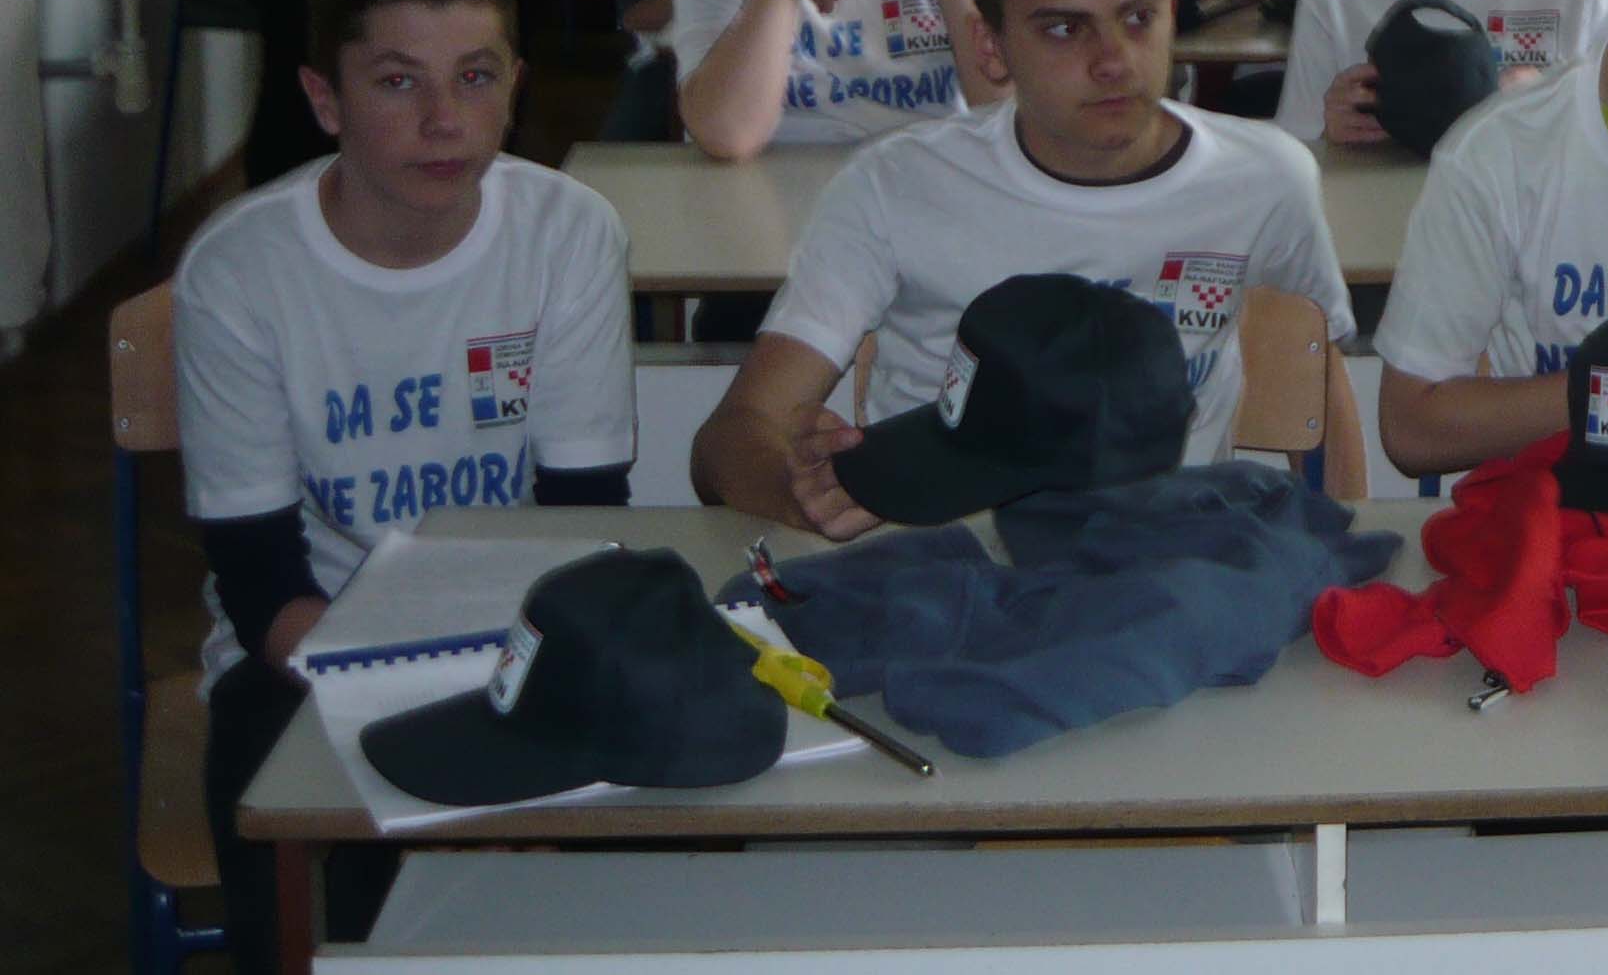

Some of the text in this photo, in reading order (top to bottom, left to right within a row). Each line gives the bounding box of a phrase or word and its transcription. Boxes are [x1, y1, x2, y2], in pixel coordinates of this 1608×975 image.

[907, 32, 949, 50] KVIN
[1504, 49, 1547, 63] KVIN
[1553, 262, 1605, 317] DA
[326, 373, 442, 444] DA SE
